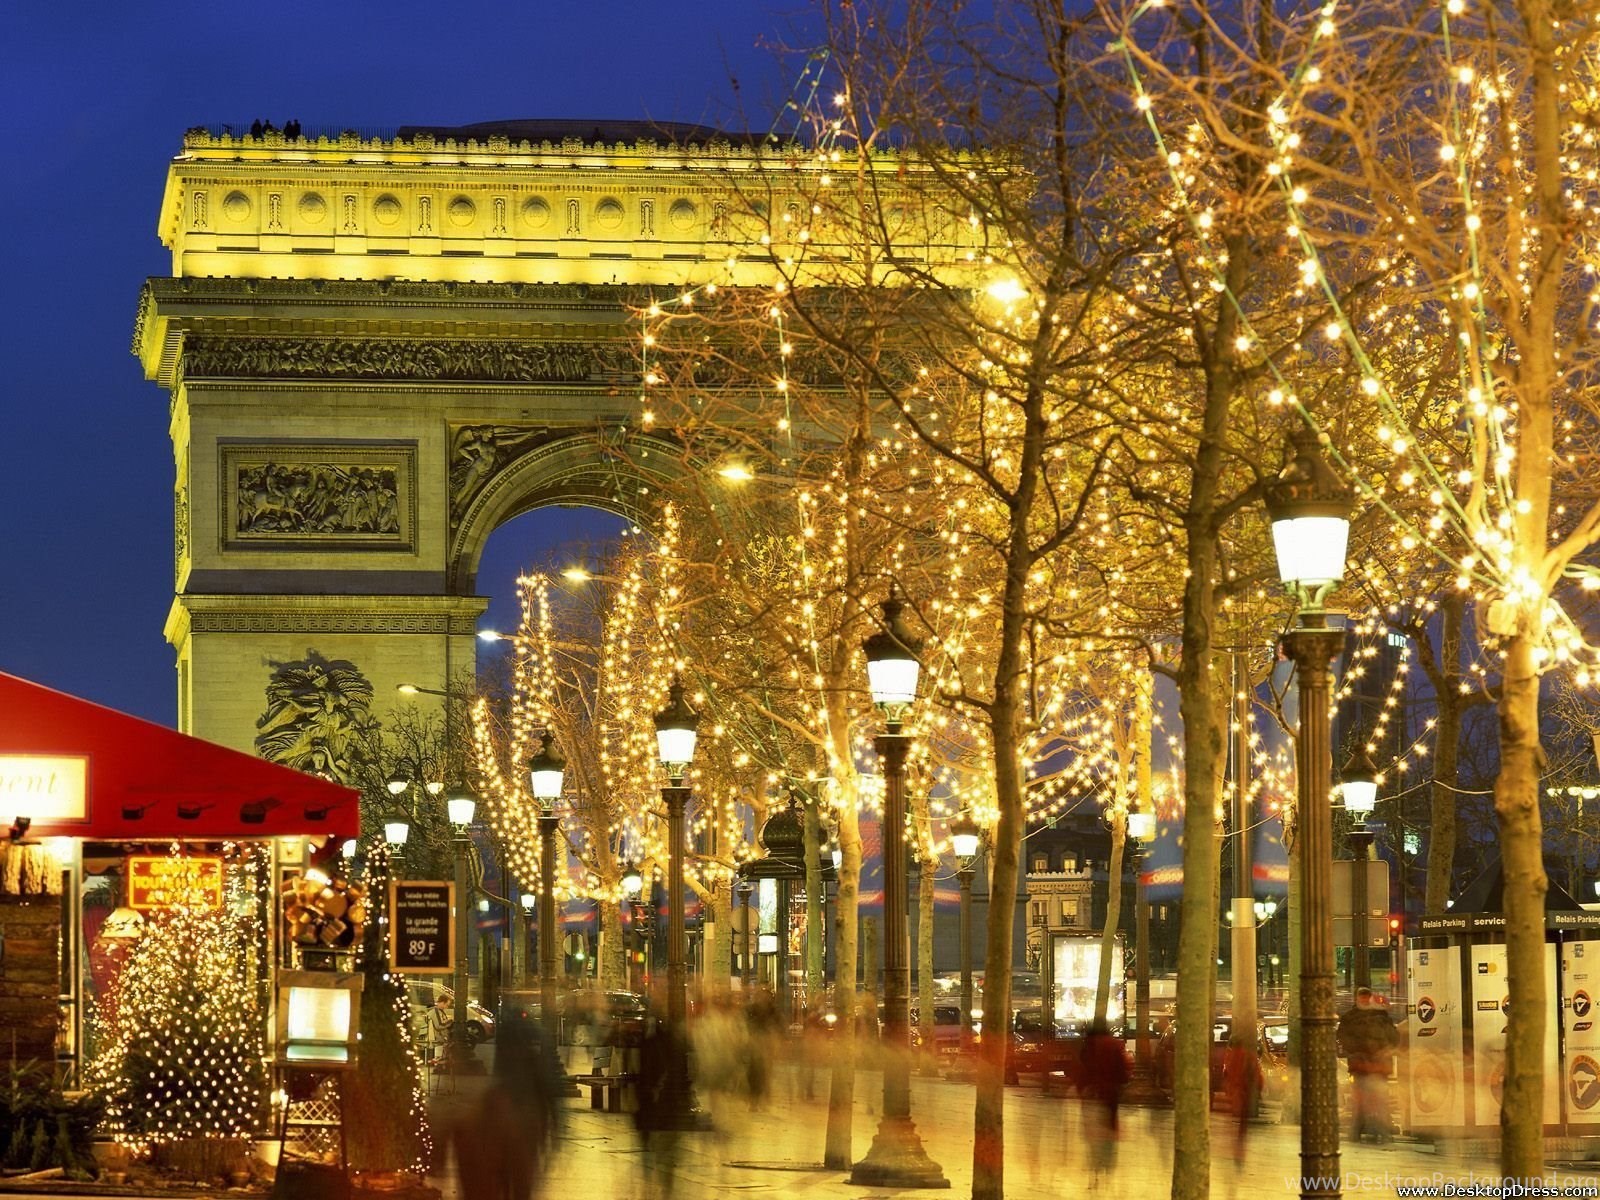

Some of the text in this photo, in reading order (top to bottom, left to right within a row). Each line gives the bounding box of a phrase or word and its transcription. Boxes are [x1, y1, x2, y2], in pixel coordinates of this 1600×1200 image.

[0, 772, 57, 794] ent
[414, 917, 439, 927] grande
[1423, 919, 1466, 928] Relais Parking
[1473, 917, 1506, 926] service
[1555, 915, 1576, 923] Relais
[408, 940, 436, 955] 89 F
